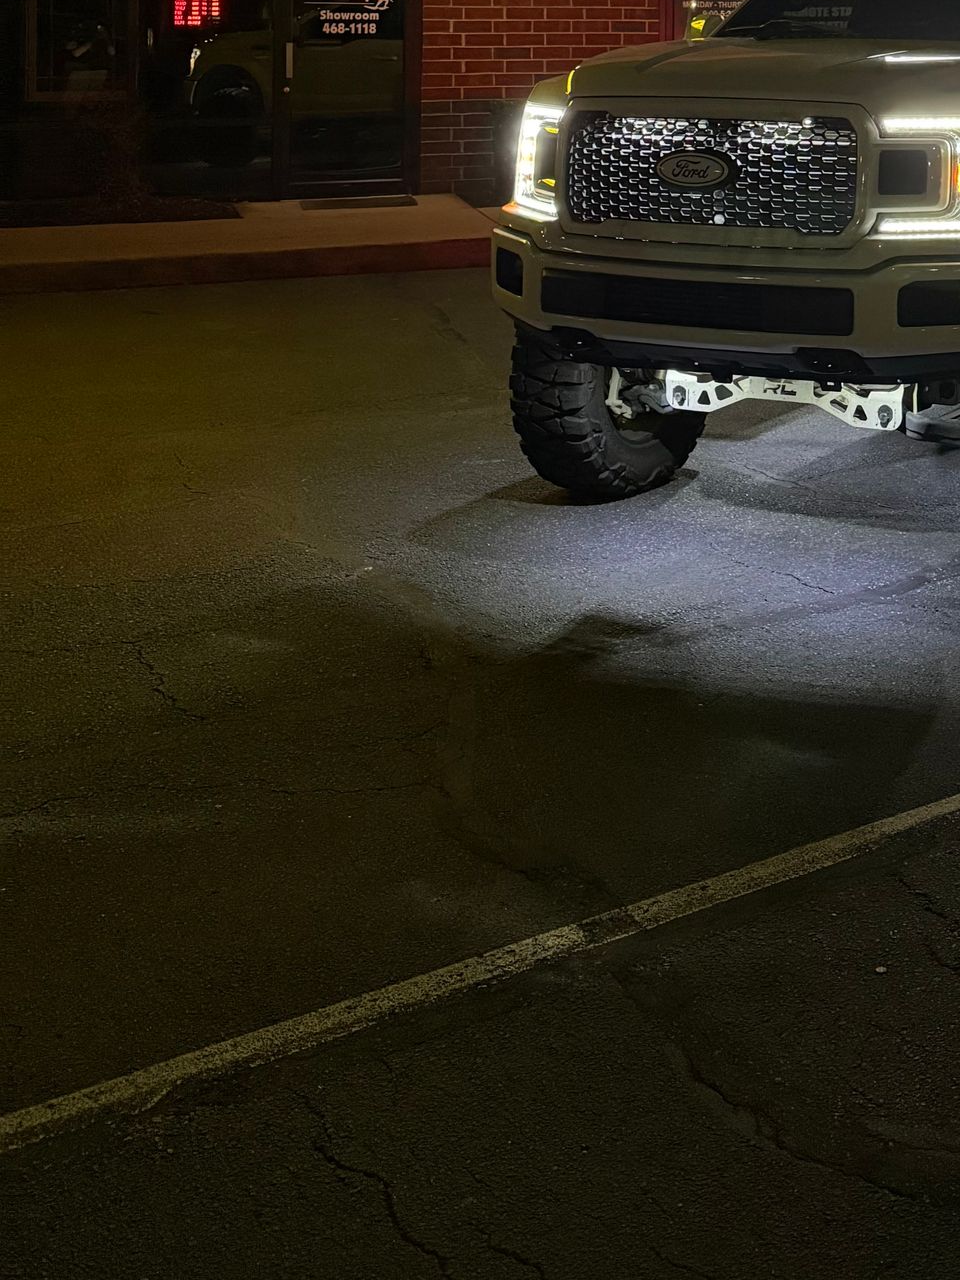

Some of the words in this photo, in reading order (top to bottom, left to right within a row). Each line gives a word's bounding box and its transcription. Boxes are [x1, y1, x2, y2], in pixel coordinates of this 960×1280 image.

[682, 1, 714, 9] MNDAY
[319, 9, 380, 21] Showroom
[322, 22, 377, 35] 468-1118
[671, 159, 710, 179] Ford
